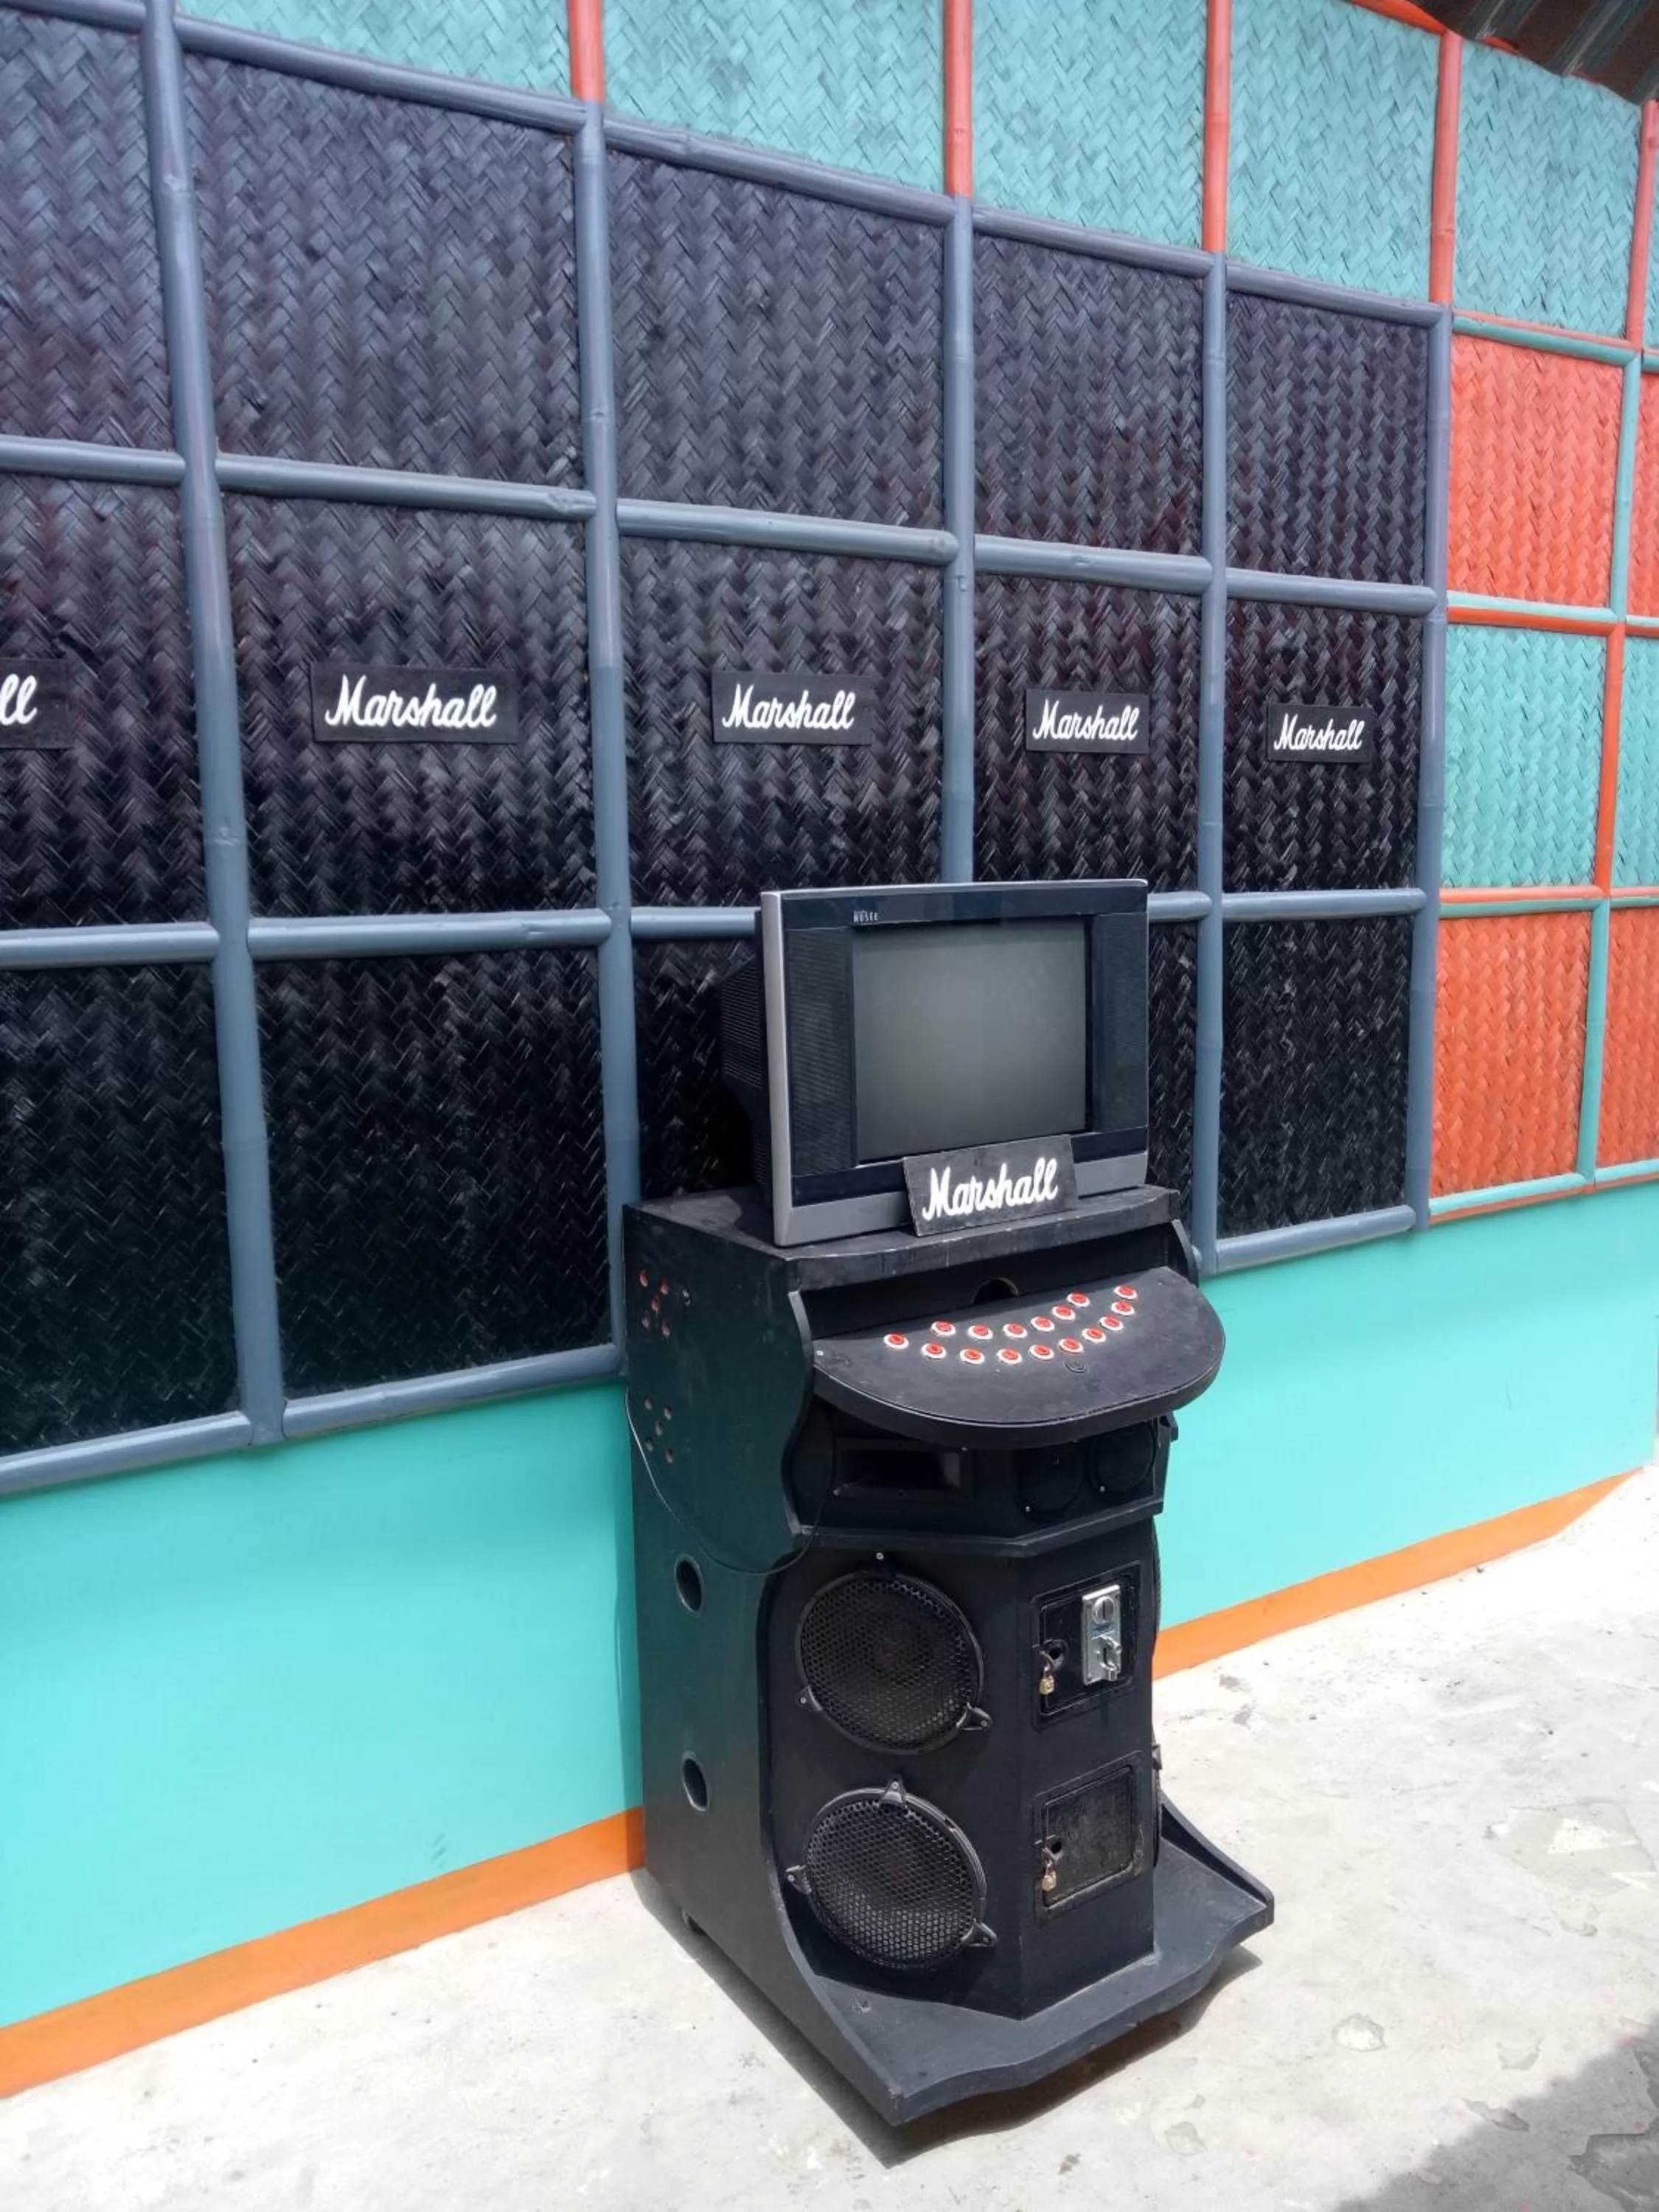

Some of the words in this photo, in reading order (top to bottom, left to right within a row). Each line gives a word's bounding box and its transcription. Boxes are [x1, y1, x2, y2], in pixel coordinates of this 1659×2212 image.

[324, 673, 498, 729] Marshall
[721, 683, 857, 731] Marshall
[1032, 698, 1140, 741] Marshall
[1273, 712, 1366, 751] Marshall
[921, 1155, 1060, 1221] Marshall
